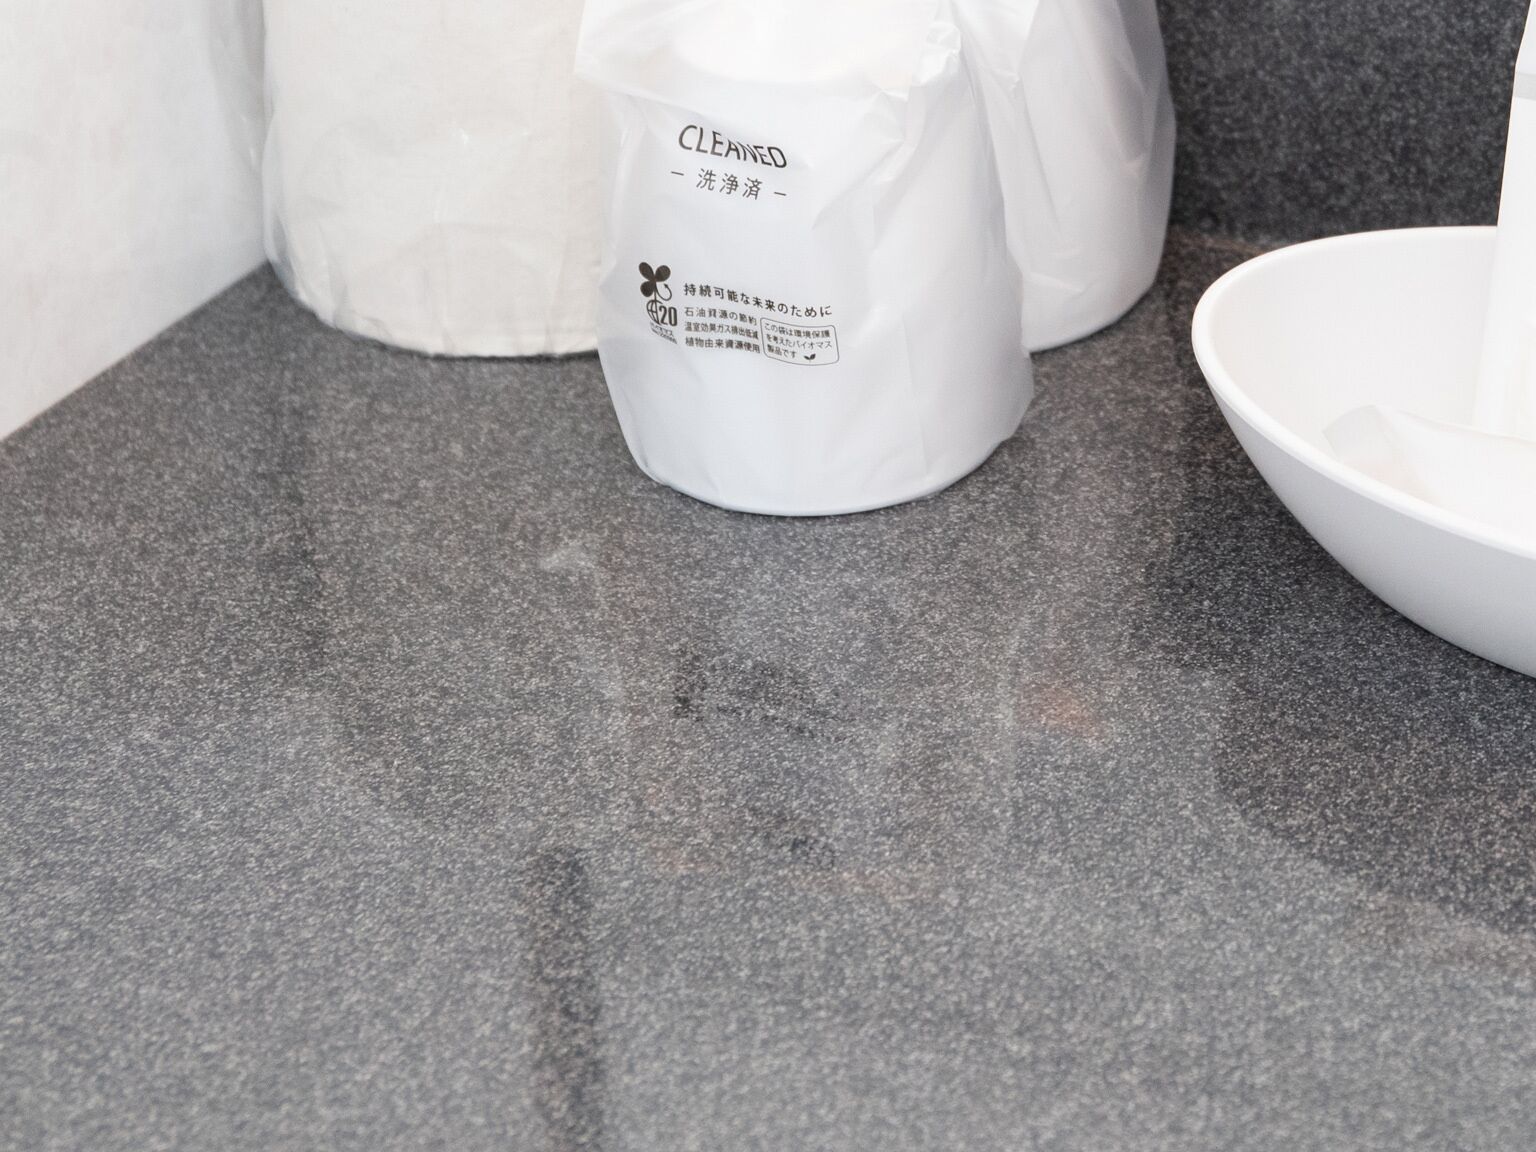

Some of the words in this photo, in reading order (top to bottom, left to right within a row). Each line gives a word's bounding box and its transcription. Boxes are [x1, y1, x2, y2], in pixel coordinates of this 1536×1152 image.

[678, 124, 788, 169] CLEANED
[684, 282, 833, 318] 持続可能な未来のために
[659, 306, 678, 327] 20
[684, 307, 758, 326] 石油資源の節約
[685, 337, 760, 354] 植物由来資源使用
